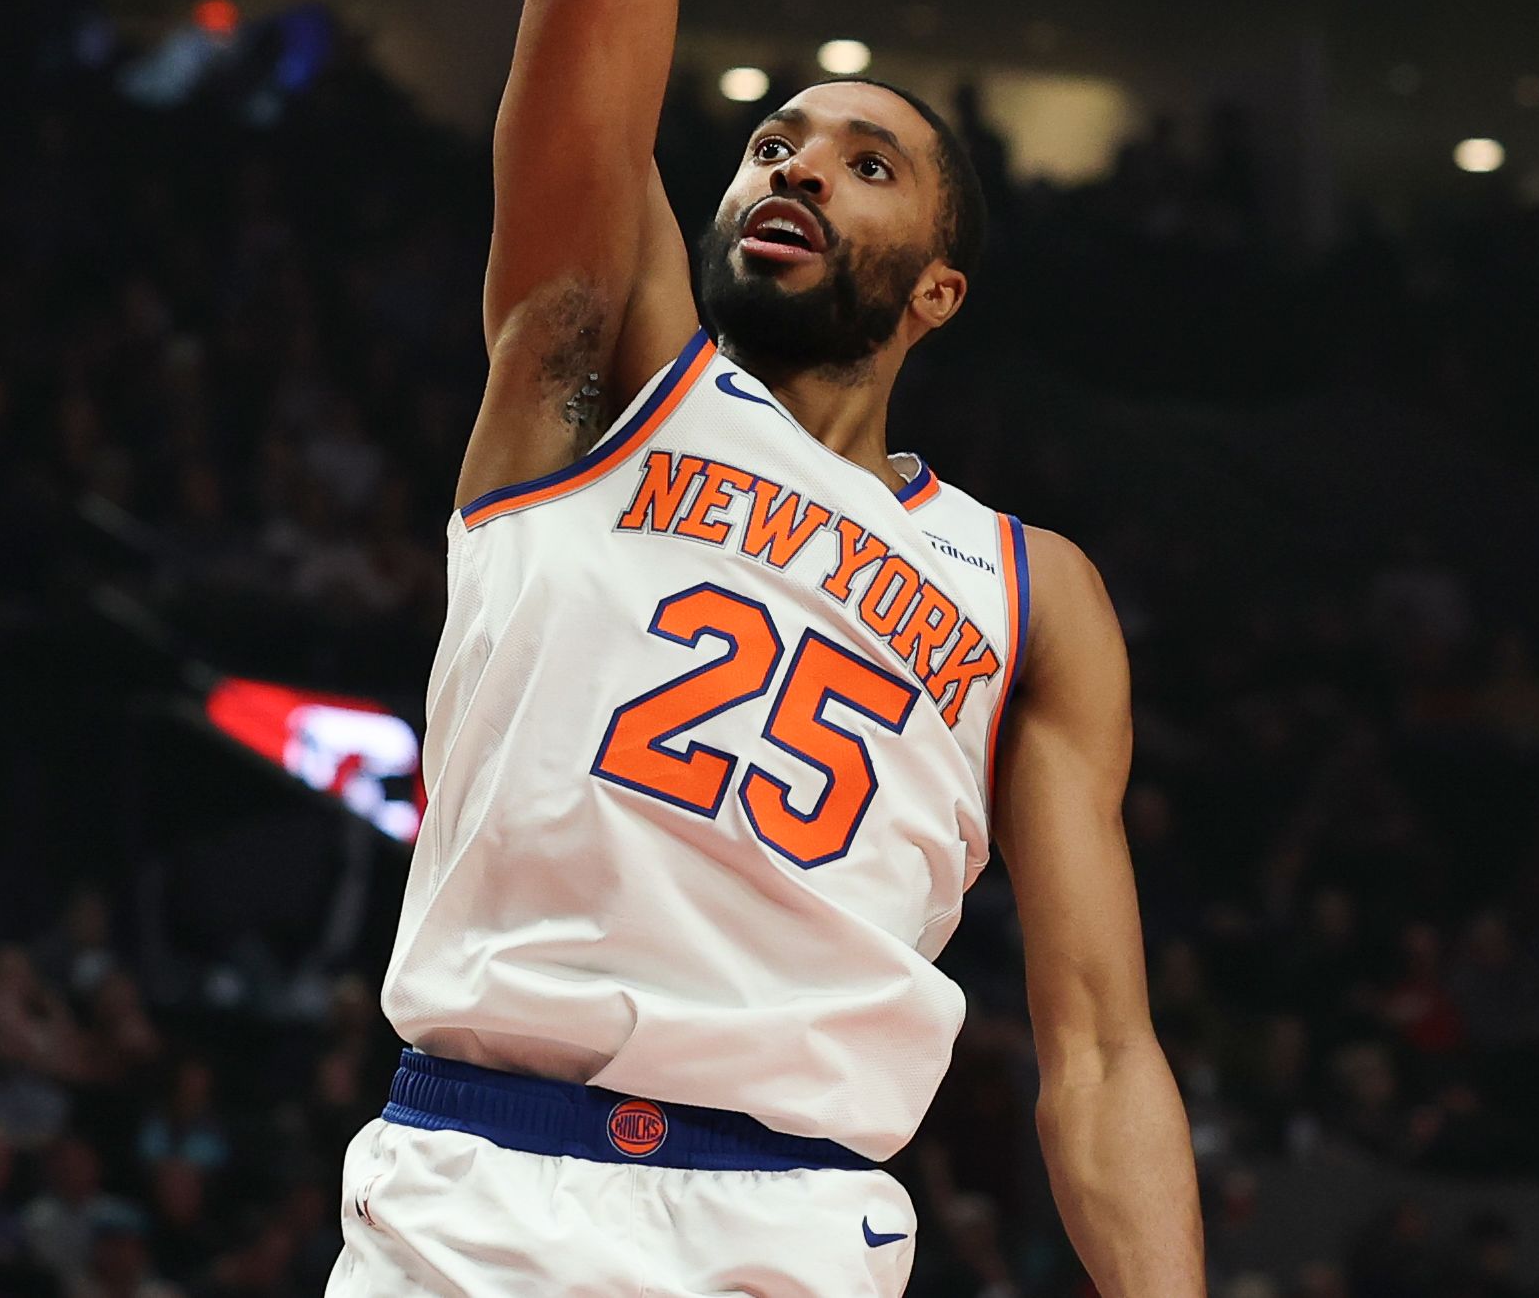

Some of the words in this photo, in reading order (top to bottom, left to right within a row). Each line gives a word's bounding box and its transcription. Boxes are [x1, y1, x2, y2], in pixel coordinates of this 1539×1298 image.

[590, 582, 921, 870] 25
[615, 450, 833, 570] NEW
[817, 517, 1003, 730] YORK
